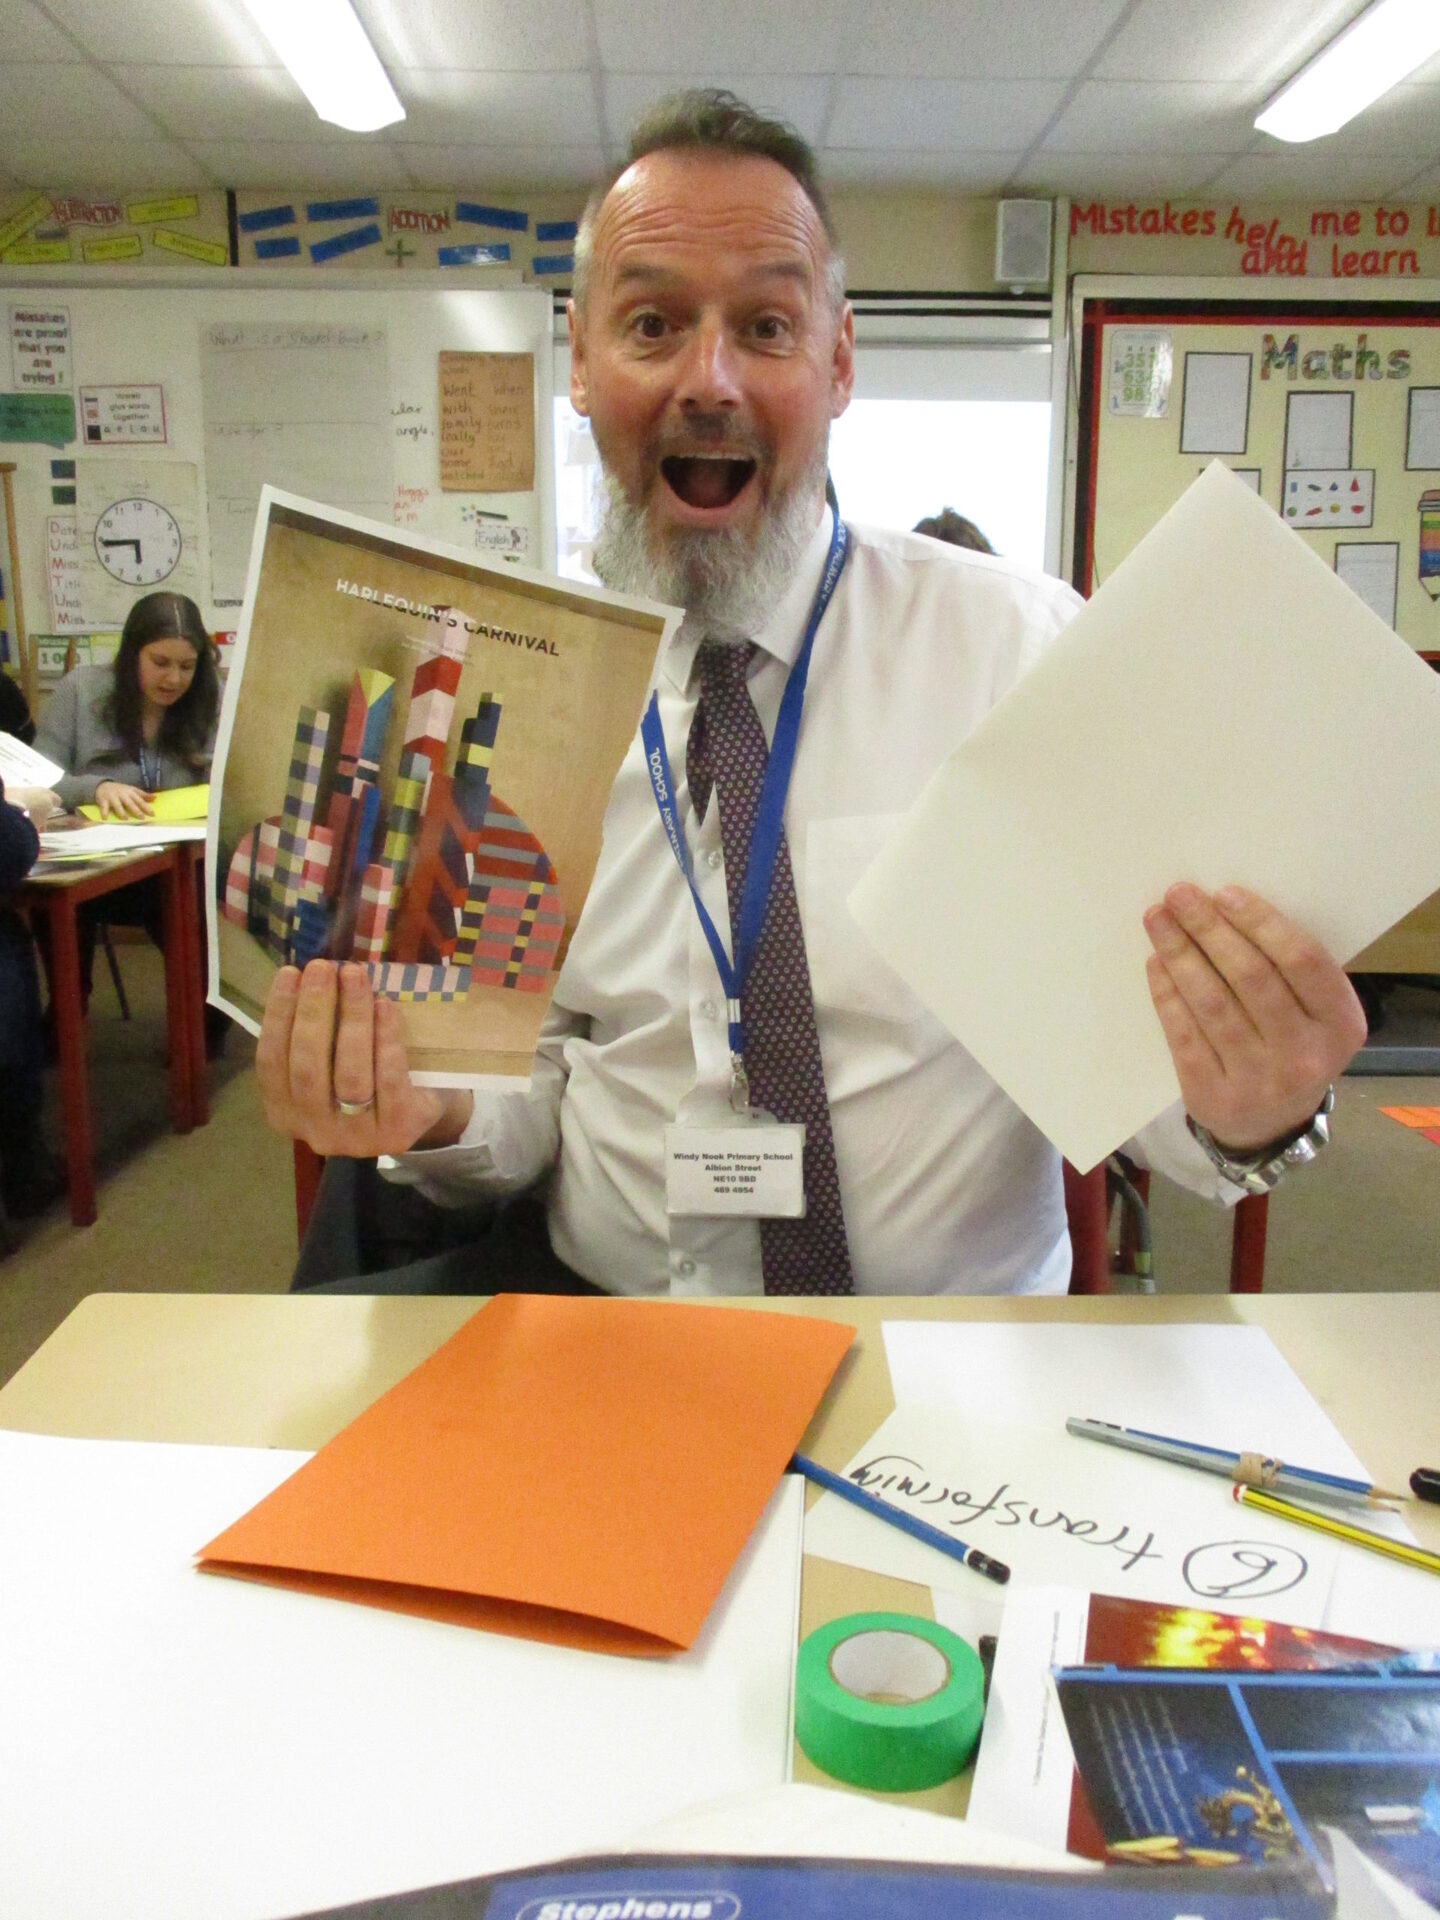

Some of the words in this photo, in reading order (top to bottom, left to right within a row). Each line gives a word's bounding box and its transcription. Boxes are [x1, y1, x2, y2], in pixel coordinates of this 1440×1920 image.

[1070, 201, 1216, 237] Mistakes
[1310, 210, 1361, 237] me
[1376, 206, 1409, 237] to
[1241, 239, 1308, 276] and
[1332, 243, 1420, 278] learn
[1260, 333, 1411, 382] Maths
[115, 506, 124, 516] 11
[133, 503, 142, 511] 12
[155, 508, 160, 518] 1
[103, 520, 113, 529] 10
[167, 522, 174, 531] 2
[155, 569, 162, 578] 5
[336, 578, 458, 628] HARLEQUIN'S
[464, 618, 560, 657] CARNIVAL
[649, 746, 668, 802] SCHOOL
[673, 1153, 700, 1162] Windy
[702, 1153, 724, 1161] Nook
[727, 1153, 761, 1162] Primary
[763, 1153, 793, 1161] School
[704, 1164, 732, 1172] Albion
[735, 1164, 762, 1172] Street
[713, 1175, 736, 1183] NE10
[537, 1897, 714, 1920] Stephens
